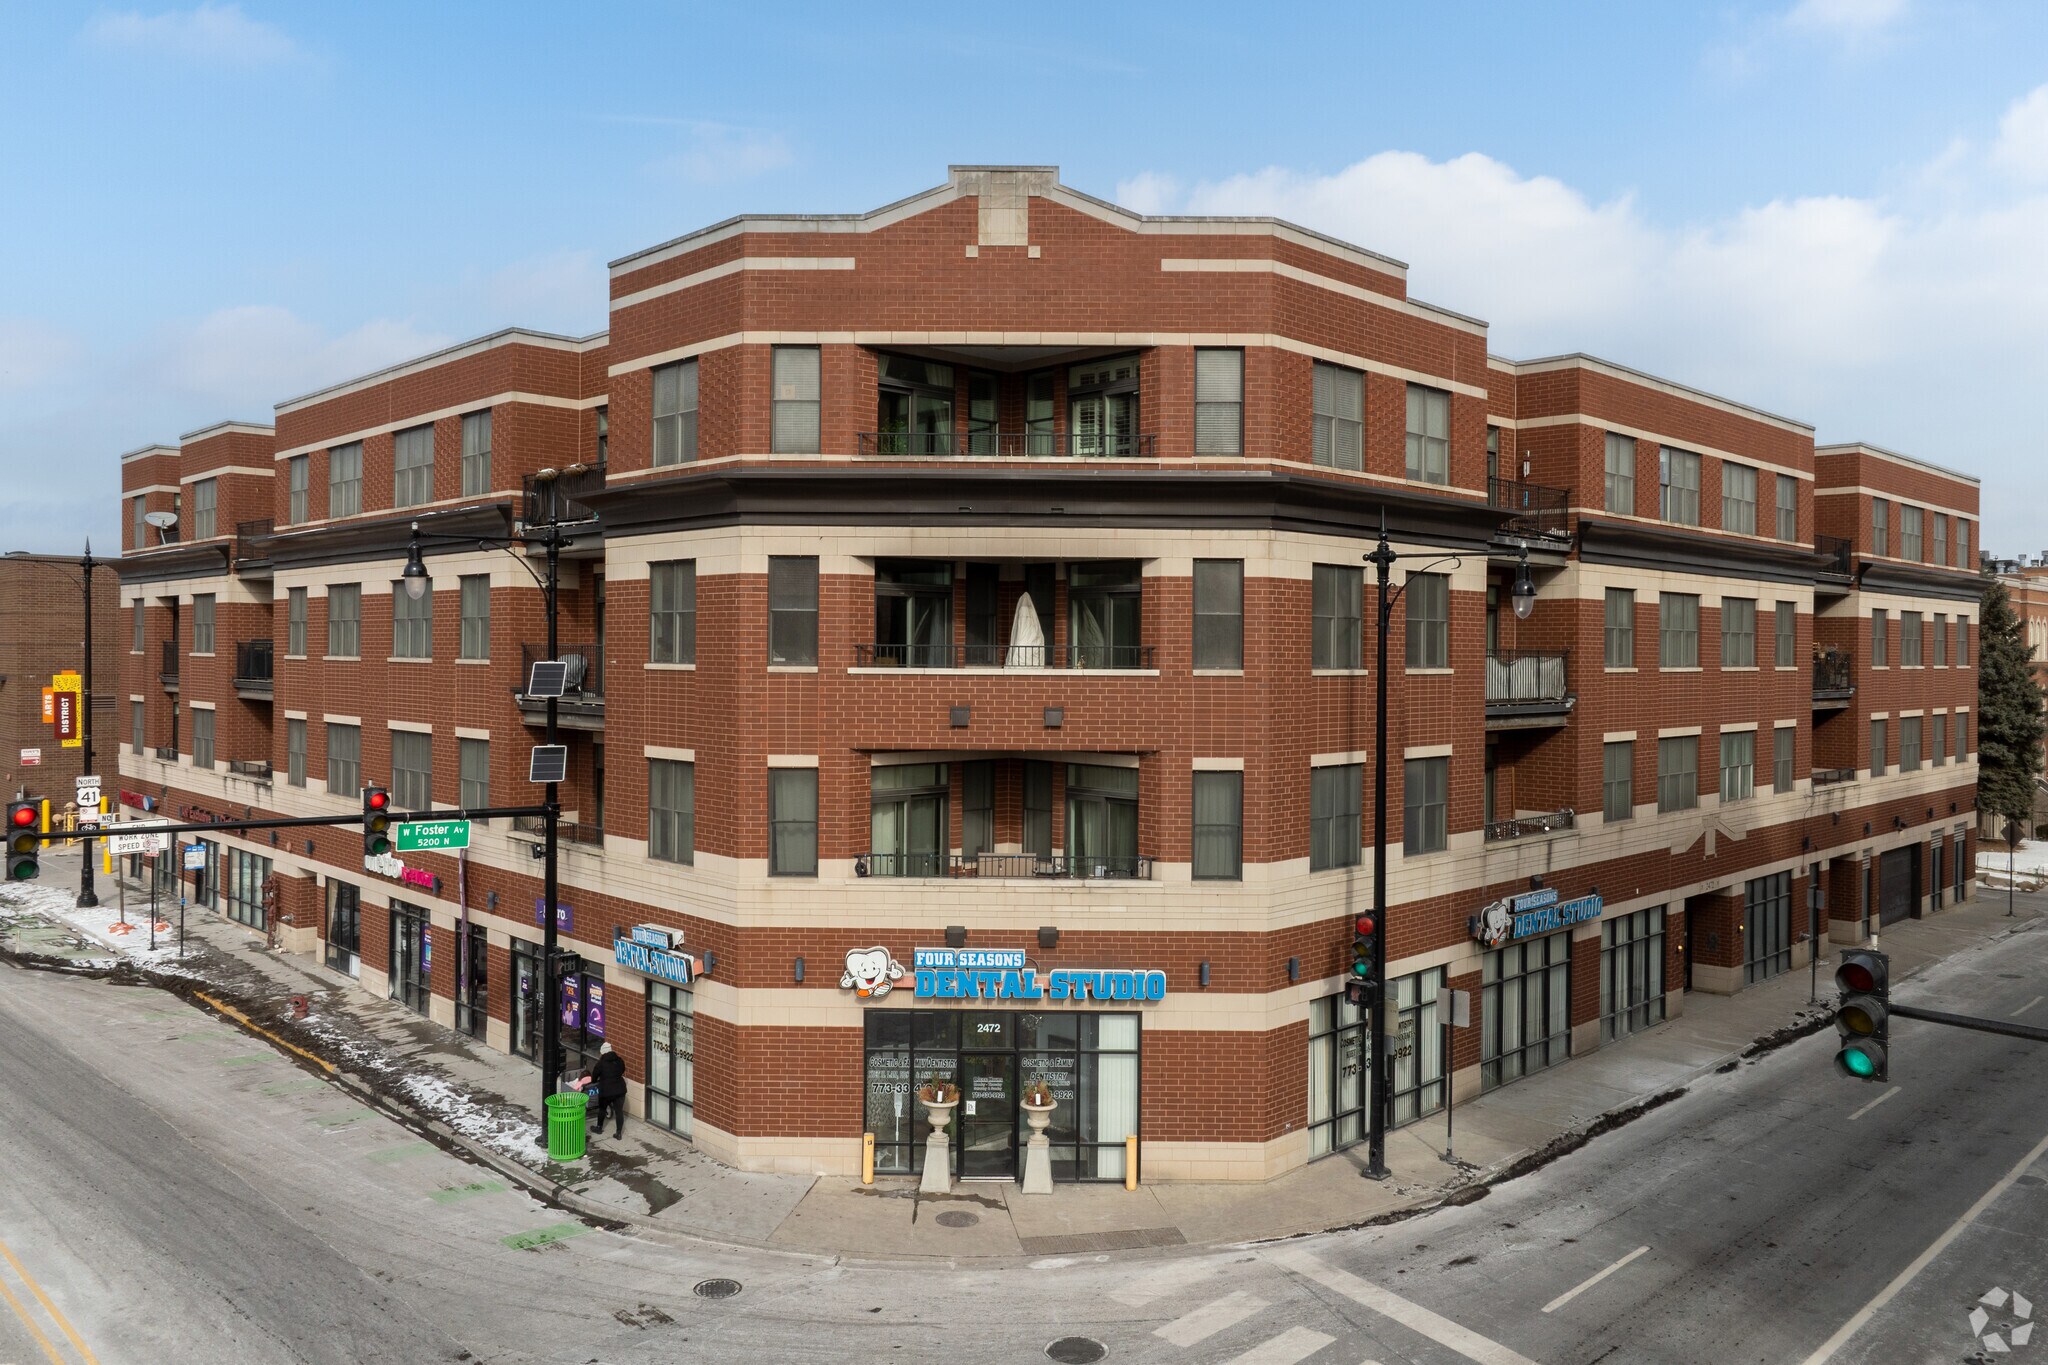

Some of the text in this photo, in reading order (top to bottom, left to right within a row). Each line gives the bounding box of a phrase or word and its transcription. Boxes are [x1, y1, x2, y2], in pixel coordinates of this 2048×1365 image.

[44, 694, 53, 716] ARTS
[61, 697, 70, 734] DISTRICT
[81, 791, 97, 803] 41
[119, 832, 159, 841] WORK ZONE
[403, 824, 465, 837] W Foster Av
[118, 842, 140, 850] SPEED
[417, 837, 450, 847] 5200 N
[1515, 890, 1558, 911] FOUR SEASONS
[1514, 896, 1603, 939] DENTAL STUDIO
[614, 940, 688, 984] DENTAL STUDIO
[916, 952, 1022, 967] FOUR SEASONS
[914, 970, 1167, 1001] DENTAL STUDIO
[977, 1023, 1001, 1034] 2472
[869, 1055, 898, 1068] COSMETIC
[927, 1056, 957, 1068] DENTISTRY
[1021, 1057, 1049, 1068] COSMETIC
[1055, 1057, 1075, 1068] FAMILY
[1029, 1071, 1069, 1081] DENTISTRY
